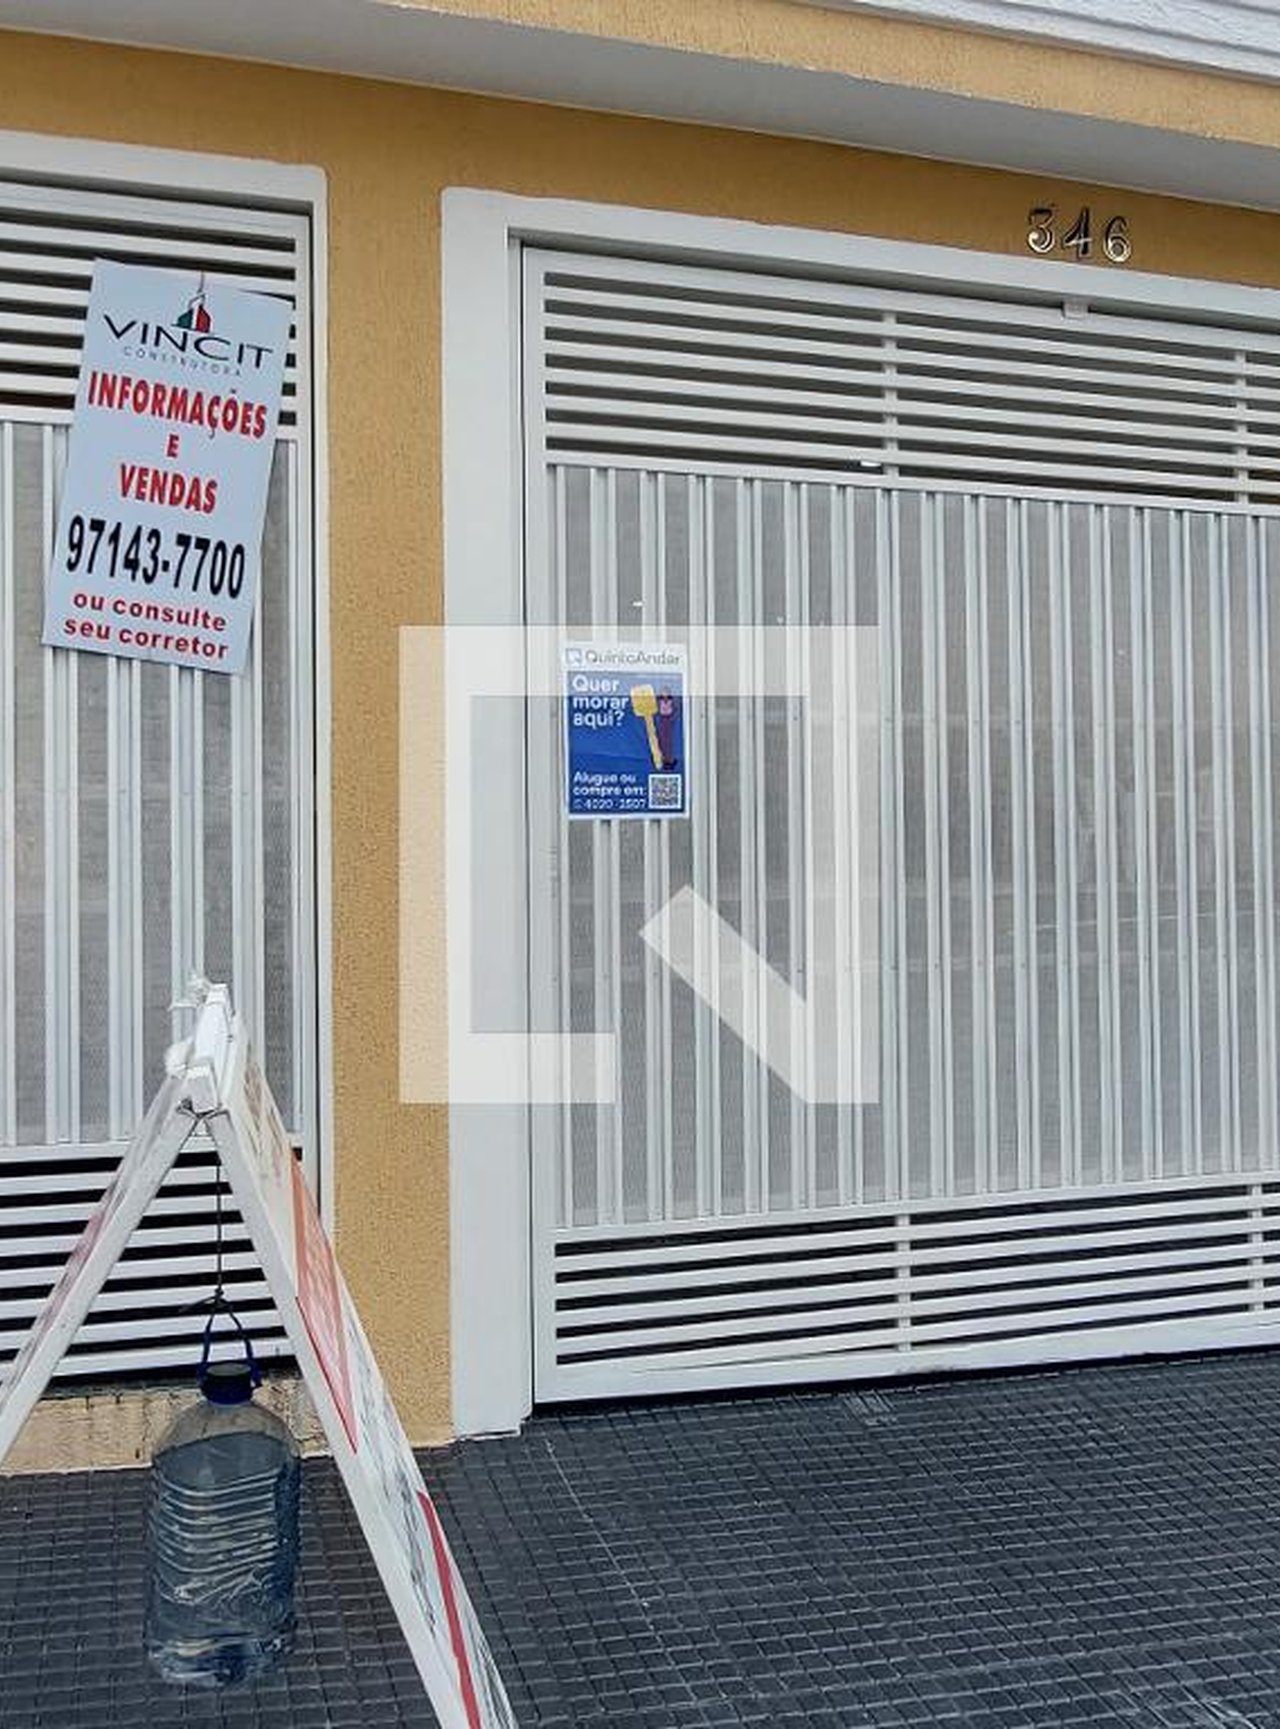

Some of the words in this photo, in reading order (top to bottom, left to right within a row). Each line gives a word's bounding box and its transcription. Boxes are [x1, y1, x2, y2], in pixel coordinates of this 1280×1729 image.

[1027, 206, 1131, 263] 346
[103, 313, 273, 369] VINCIT
[123, 346, 242, 377] CONSTRUTORA
[87, 370, 268, 439] INFORMAÇÕES
[166, 433, 179, 458] E
[120, 463, 218, 514] VENDAS
[66, 515, 246, 599] 97143-7700
[73, 592, 104, 611] ou
[113, 596, 227, 633] consulte
[63, 614, 110, 641] seu
[118, 622, 229, 660] corretor
[572, 675, 620, 692] Quer
[573, 696, 629, 710] morar
[573, 710, 624, 729] aqui?
[572, 786, 621, 797] compre
[574, 771, 618, 786] Alugue
[620, 774, 636, 783] ou
